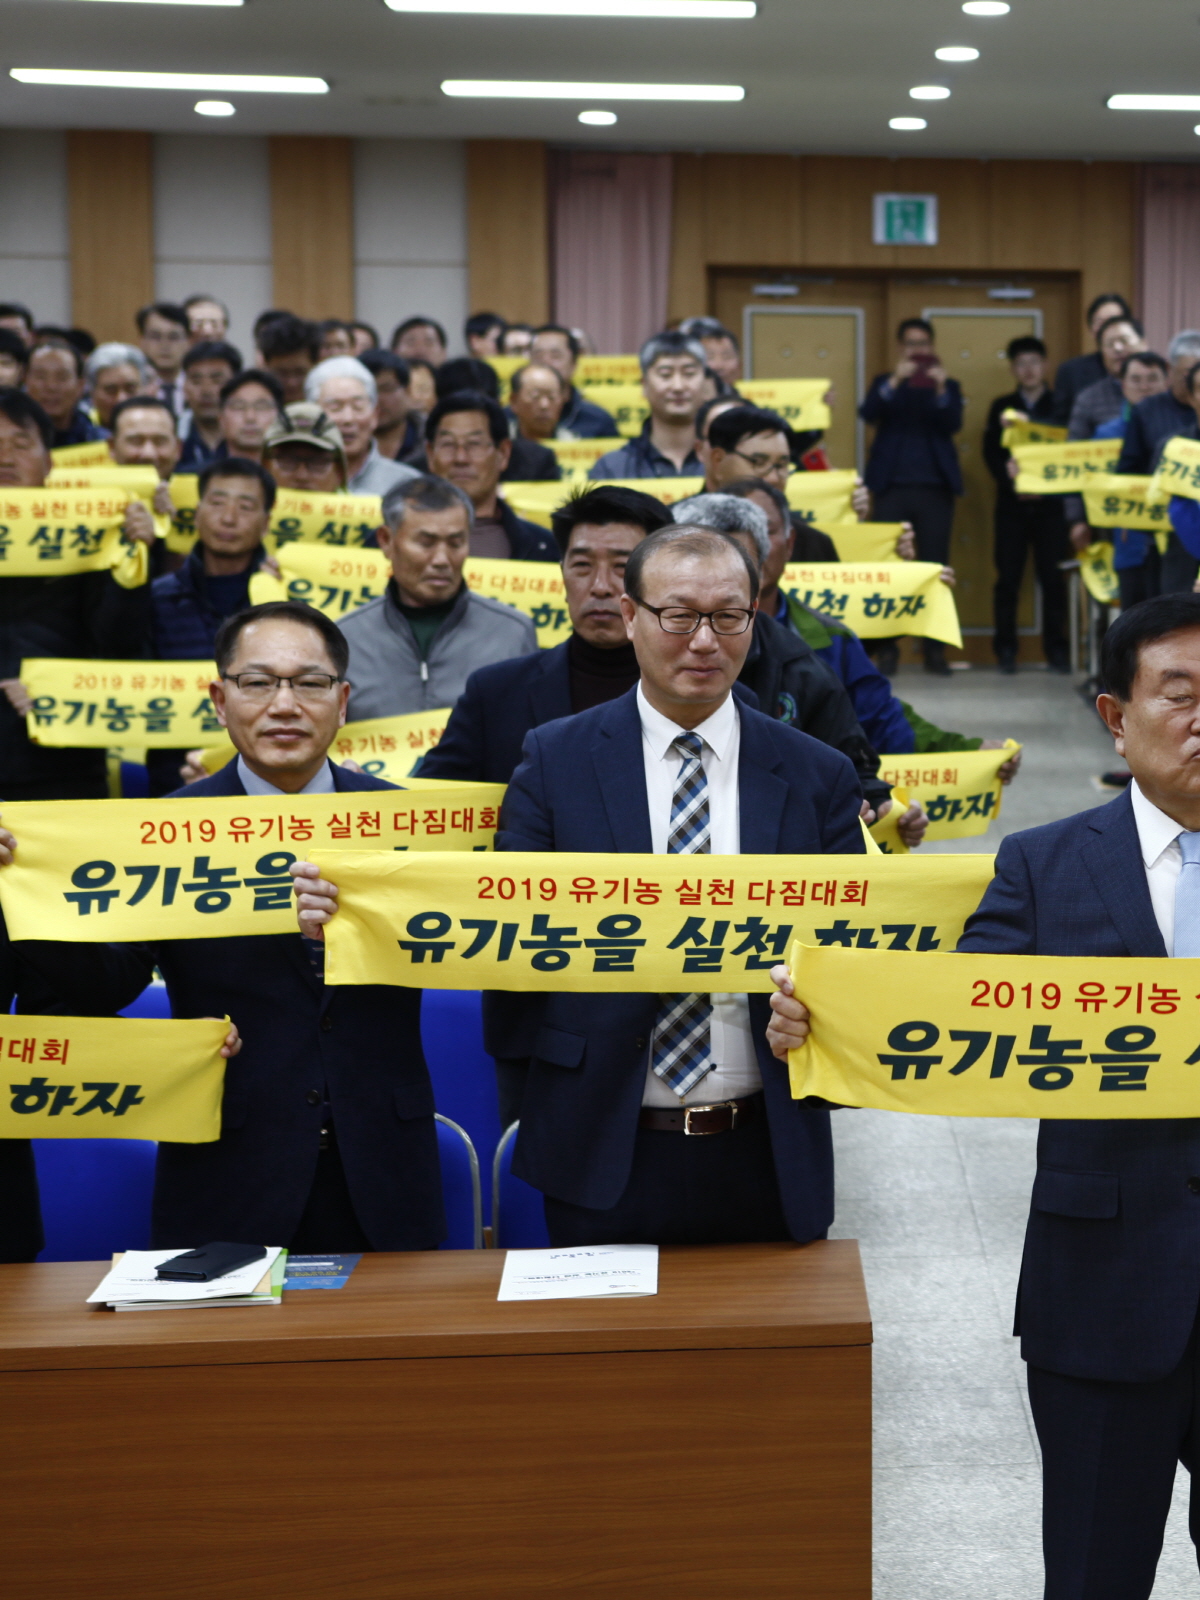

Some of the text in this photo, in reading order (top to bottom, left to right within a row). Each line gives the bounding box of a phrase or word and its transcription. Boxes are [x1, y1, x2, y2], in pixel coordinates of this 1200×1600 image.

[28, 525, 104, 560] 실천
[822, 570, 890, 585] 다짐대회
[863, 593, 927, 619] 하자
[73, 673, 124, 690] 2019
[131, 675, 186, 691] 유기농
[32, 695, 178, 733] 유기농을
[337, 734, 397, 758] 유기농
[140, 805, 499, 844] 2019 유기농 실천 다짐대회
[926, 792, 996, 822] 하자
[63, 850, 298, 916] 유기농을
[477, 876, 869, 907] 2019 유기농 실천 다짐대회
[398, 911, 647, 973] 유기농을
[666, 915, 793, 974] 실천
[971, 980, 1062, 1010] 2019
[1074, 980, 1182, 1015] 유기농
[877, 1021, 1161, 1092] 유기농을
[10, 1077, 146, 1117] 하자
